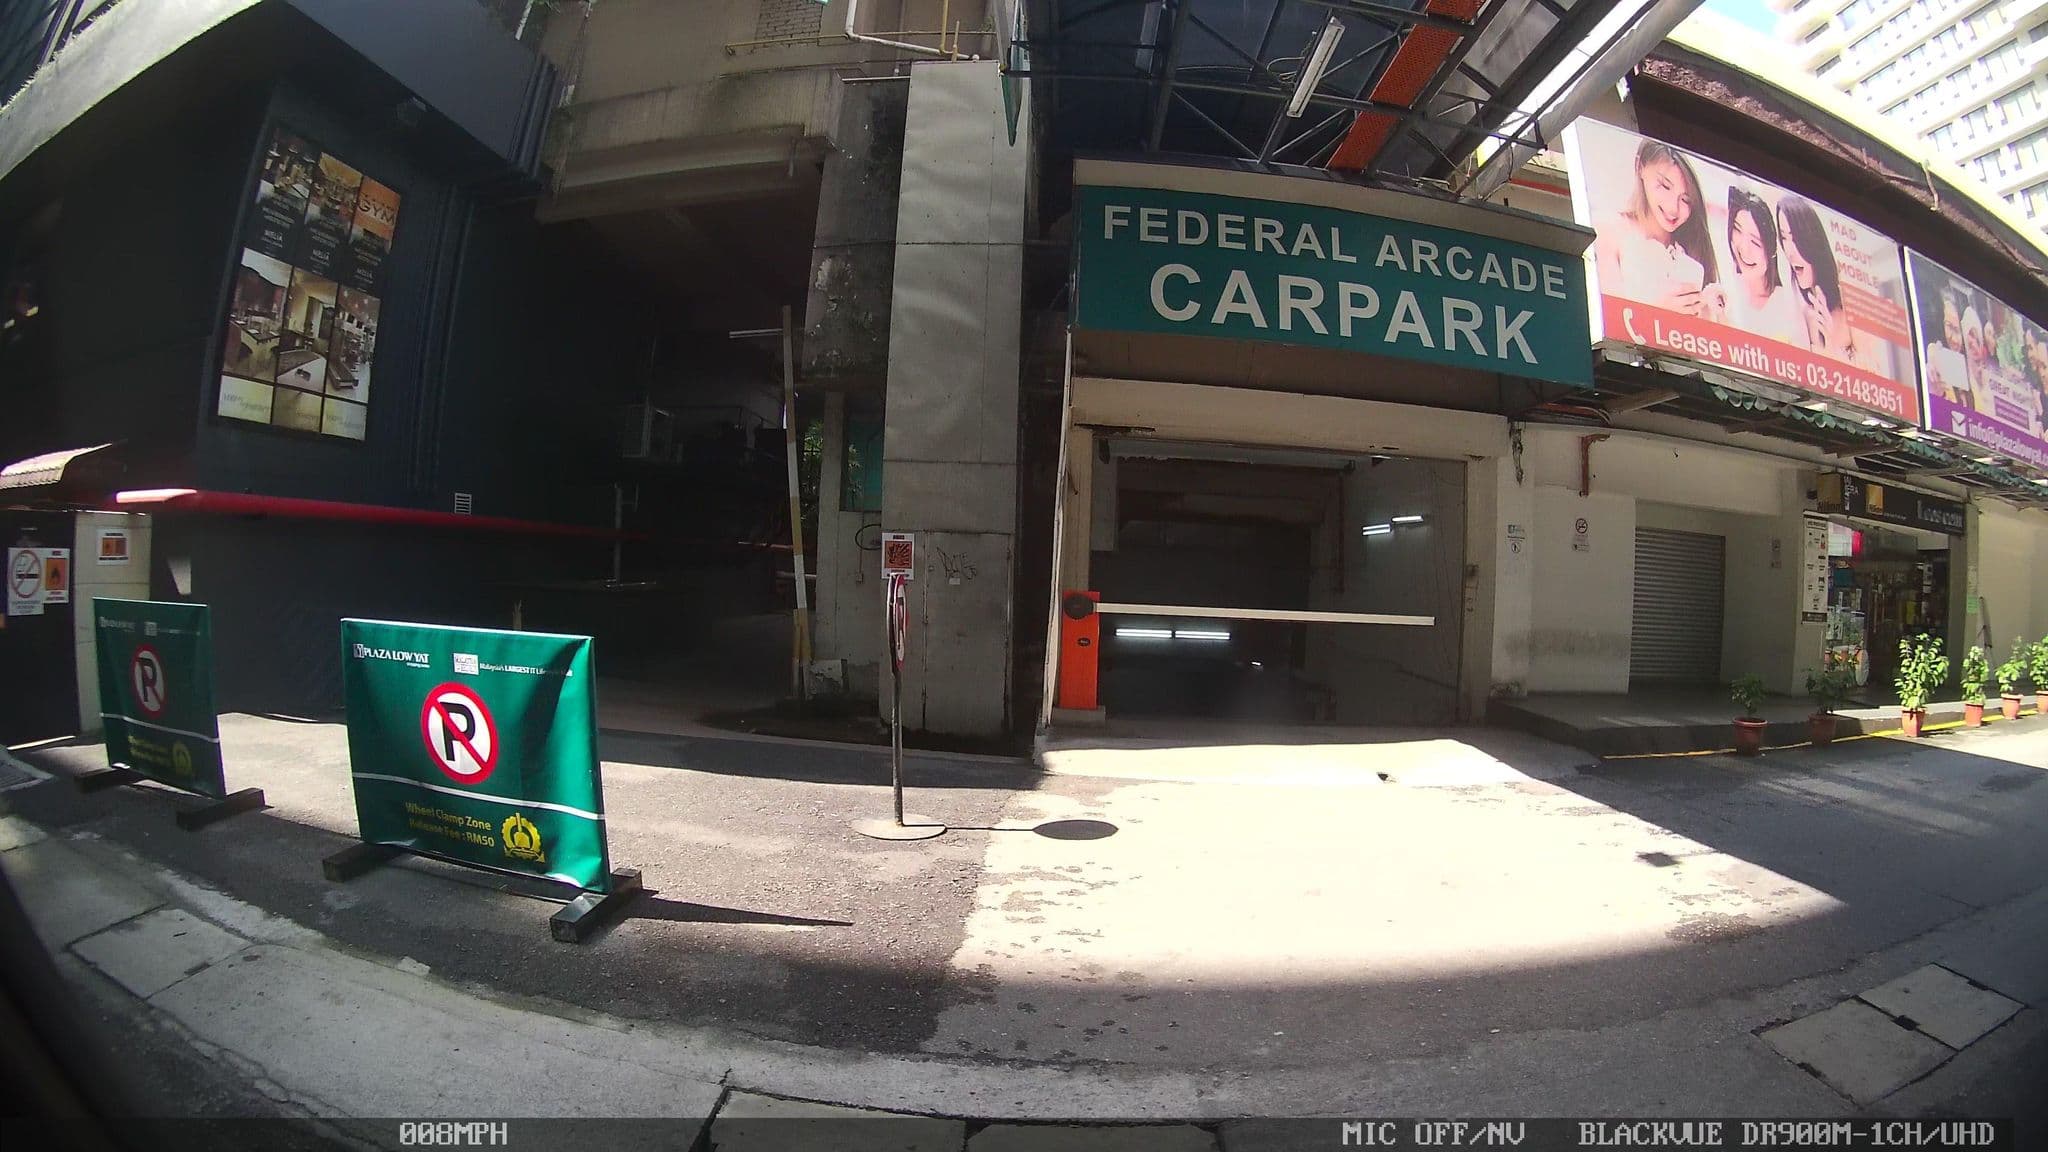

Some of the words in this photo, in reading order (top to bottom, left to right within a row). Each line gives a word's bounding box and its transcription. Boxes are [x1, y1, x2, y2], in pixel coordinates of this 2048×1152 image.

[357, 198, 395, 225] GYM
[1830, 220, 1857, 241] MAD
[1104, 205, 1357, 263] FEDERAL
[1375, 234, 1567, 300] ARCADE
[1835, 241, 1873, 265] ABOUT
[1840, 262, 1880, 289] MOBILE
[1150, 263, 1539, 364] CARPARK
[1653, 319, 1722, 359] Lease
[1728, 343, 1769, 373] with
[1775, 357, 1801, 383] us:
[1806, 363, 1903, 414] 03-21483651
[364, 647, 391, 660] PLAZA
[436, 808, 464, 826] Clamp
[465, 815, 492, 831] Zone
